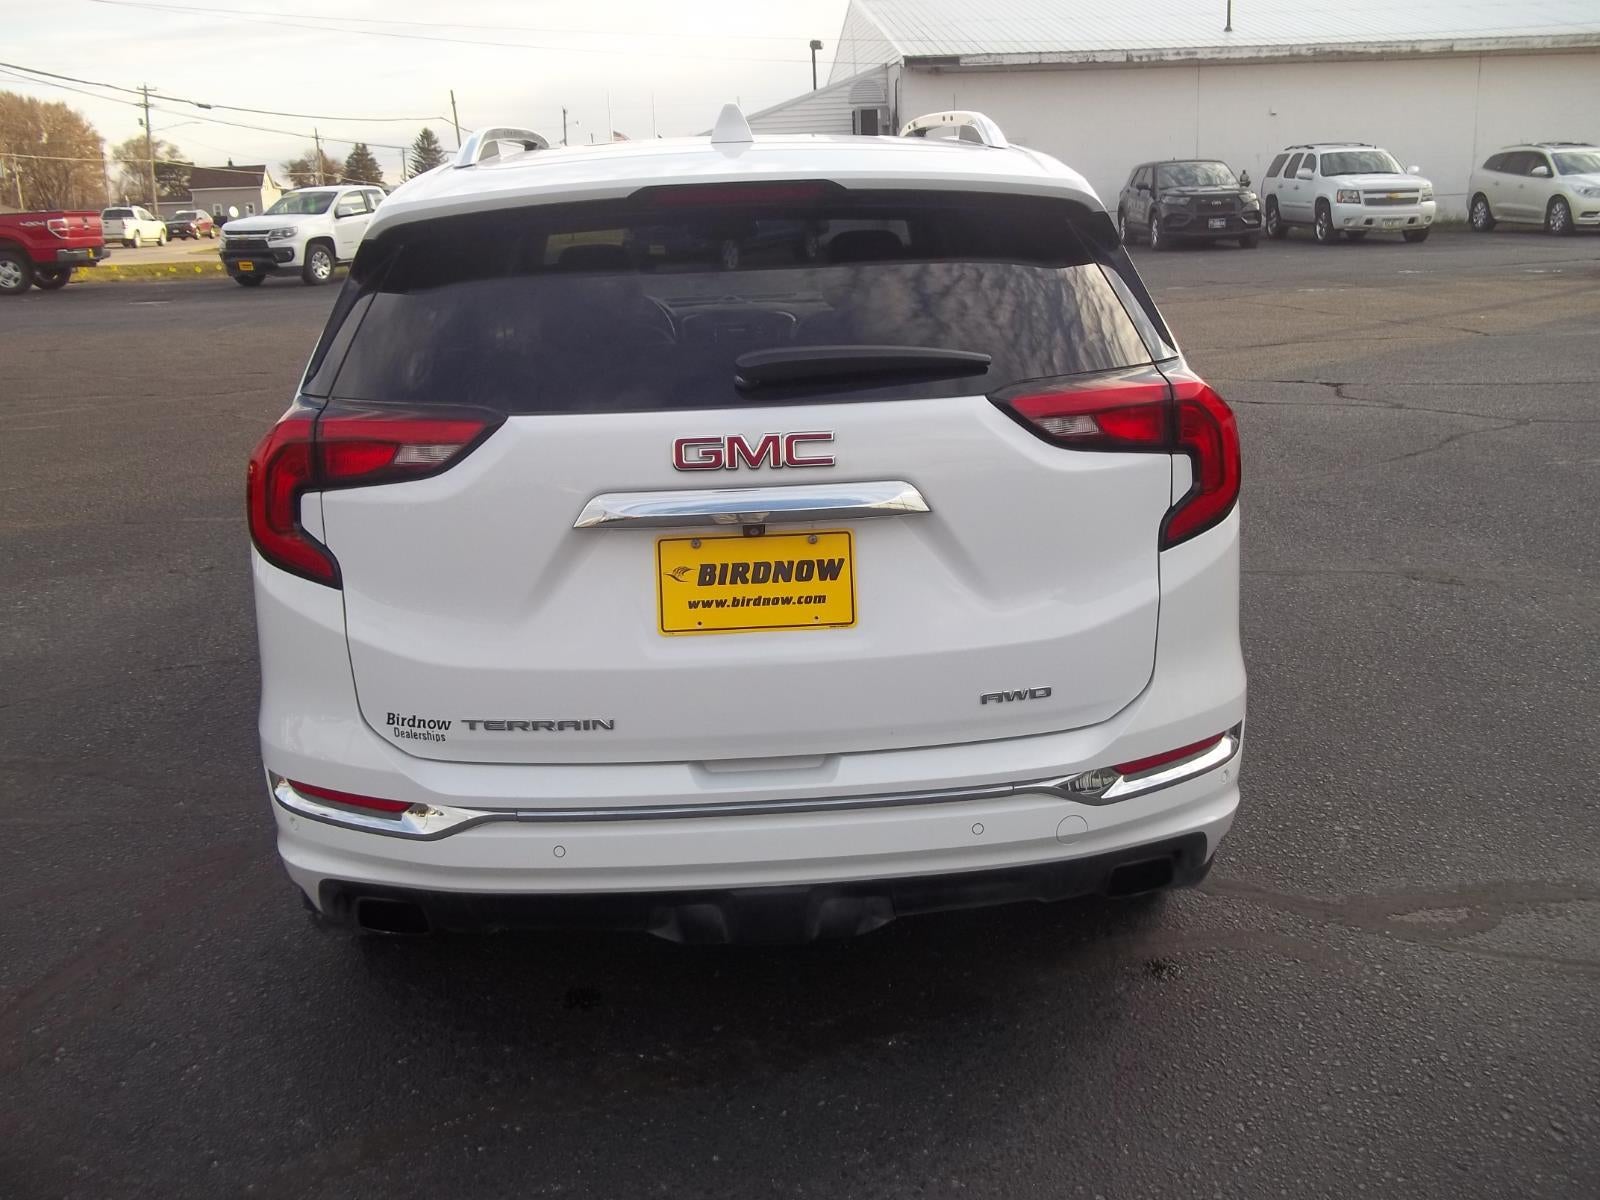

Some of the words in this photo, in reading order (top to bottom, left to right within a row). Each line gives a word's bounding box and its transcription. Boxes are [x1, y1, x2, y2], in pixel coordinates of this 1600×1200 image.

[672, 431, 836, 472] GMC
[697, 558, 845, 587] BIRDNOW
[687, 594, 827, 610] www.birdnow.com
[980, 686, 1052, 705] AWD
[386, 712, 452, 731] Birdnow
[461, 719, 615, 732] TERRAIN
[394, 727, 446, 742] Dealerships
